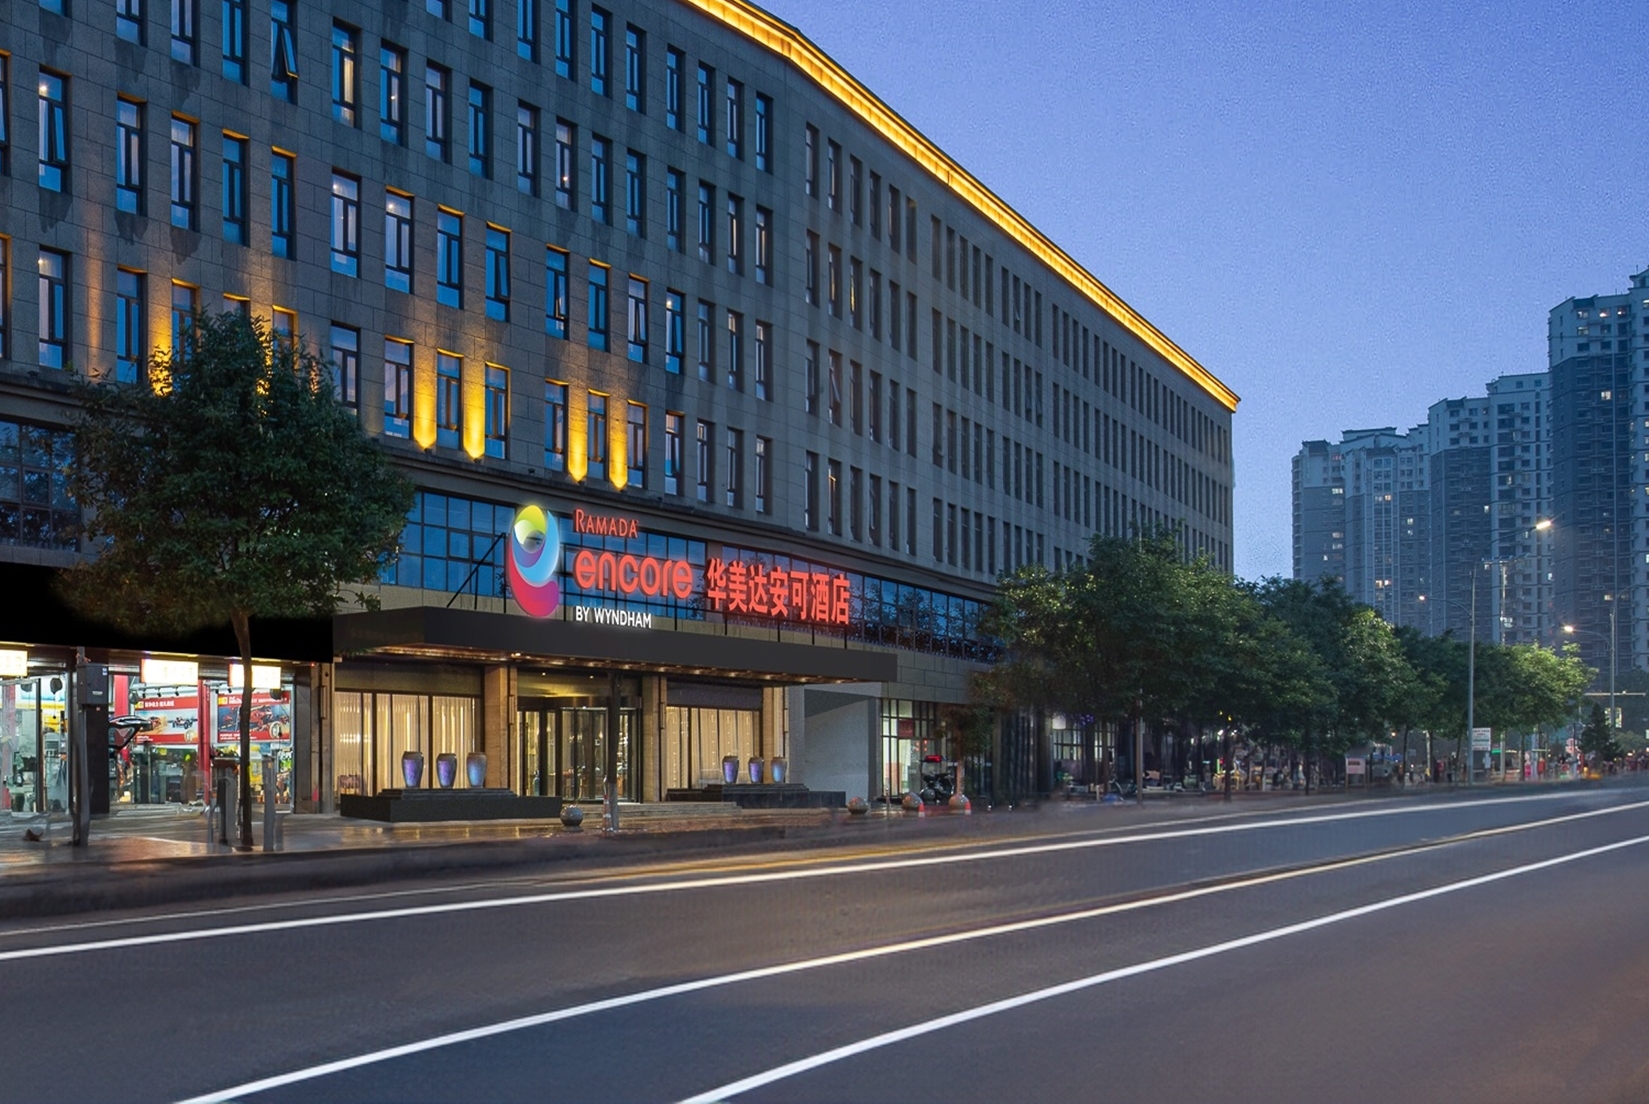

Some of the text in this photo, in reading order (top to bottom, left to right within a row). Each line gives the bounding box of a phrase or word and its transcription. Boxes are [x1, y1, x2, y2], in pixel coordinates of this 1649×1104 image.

[574, 508, 639, 538] RAMADA
[575, 550, 693, 599] encore
[707, 558, 850, 625] 华美达安可酒店
[575, 605, 652, 629] BY WYNDHAM
